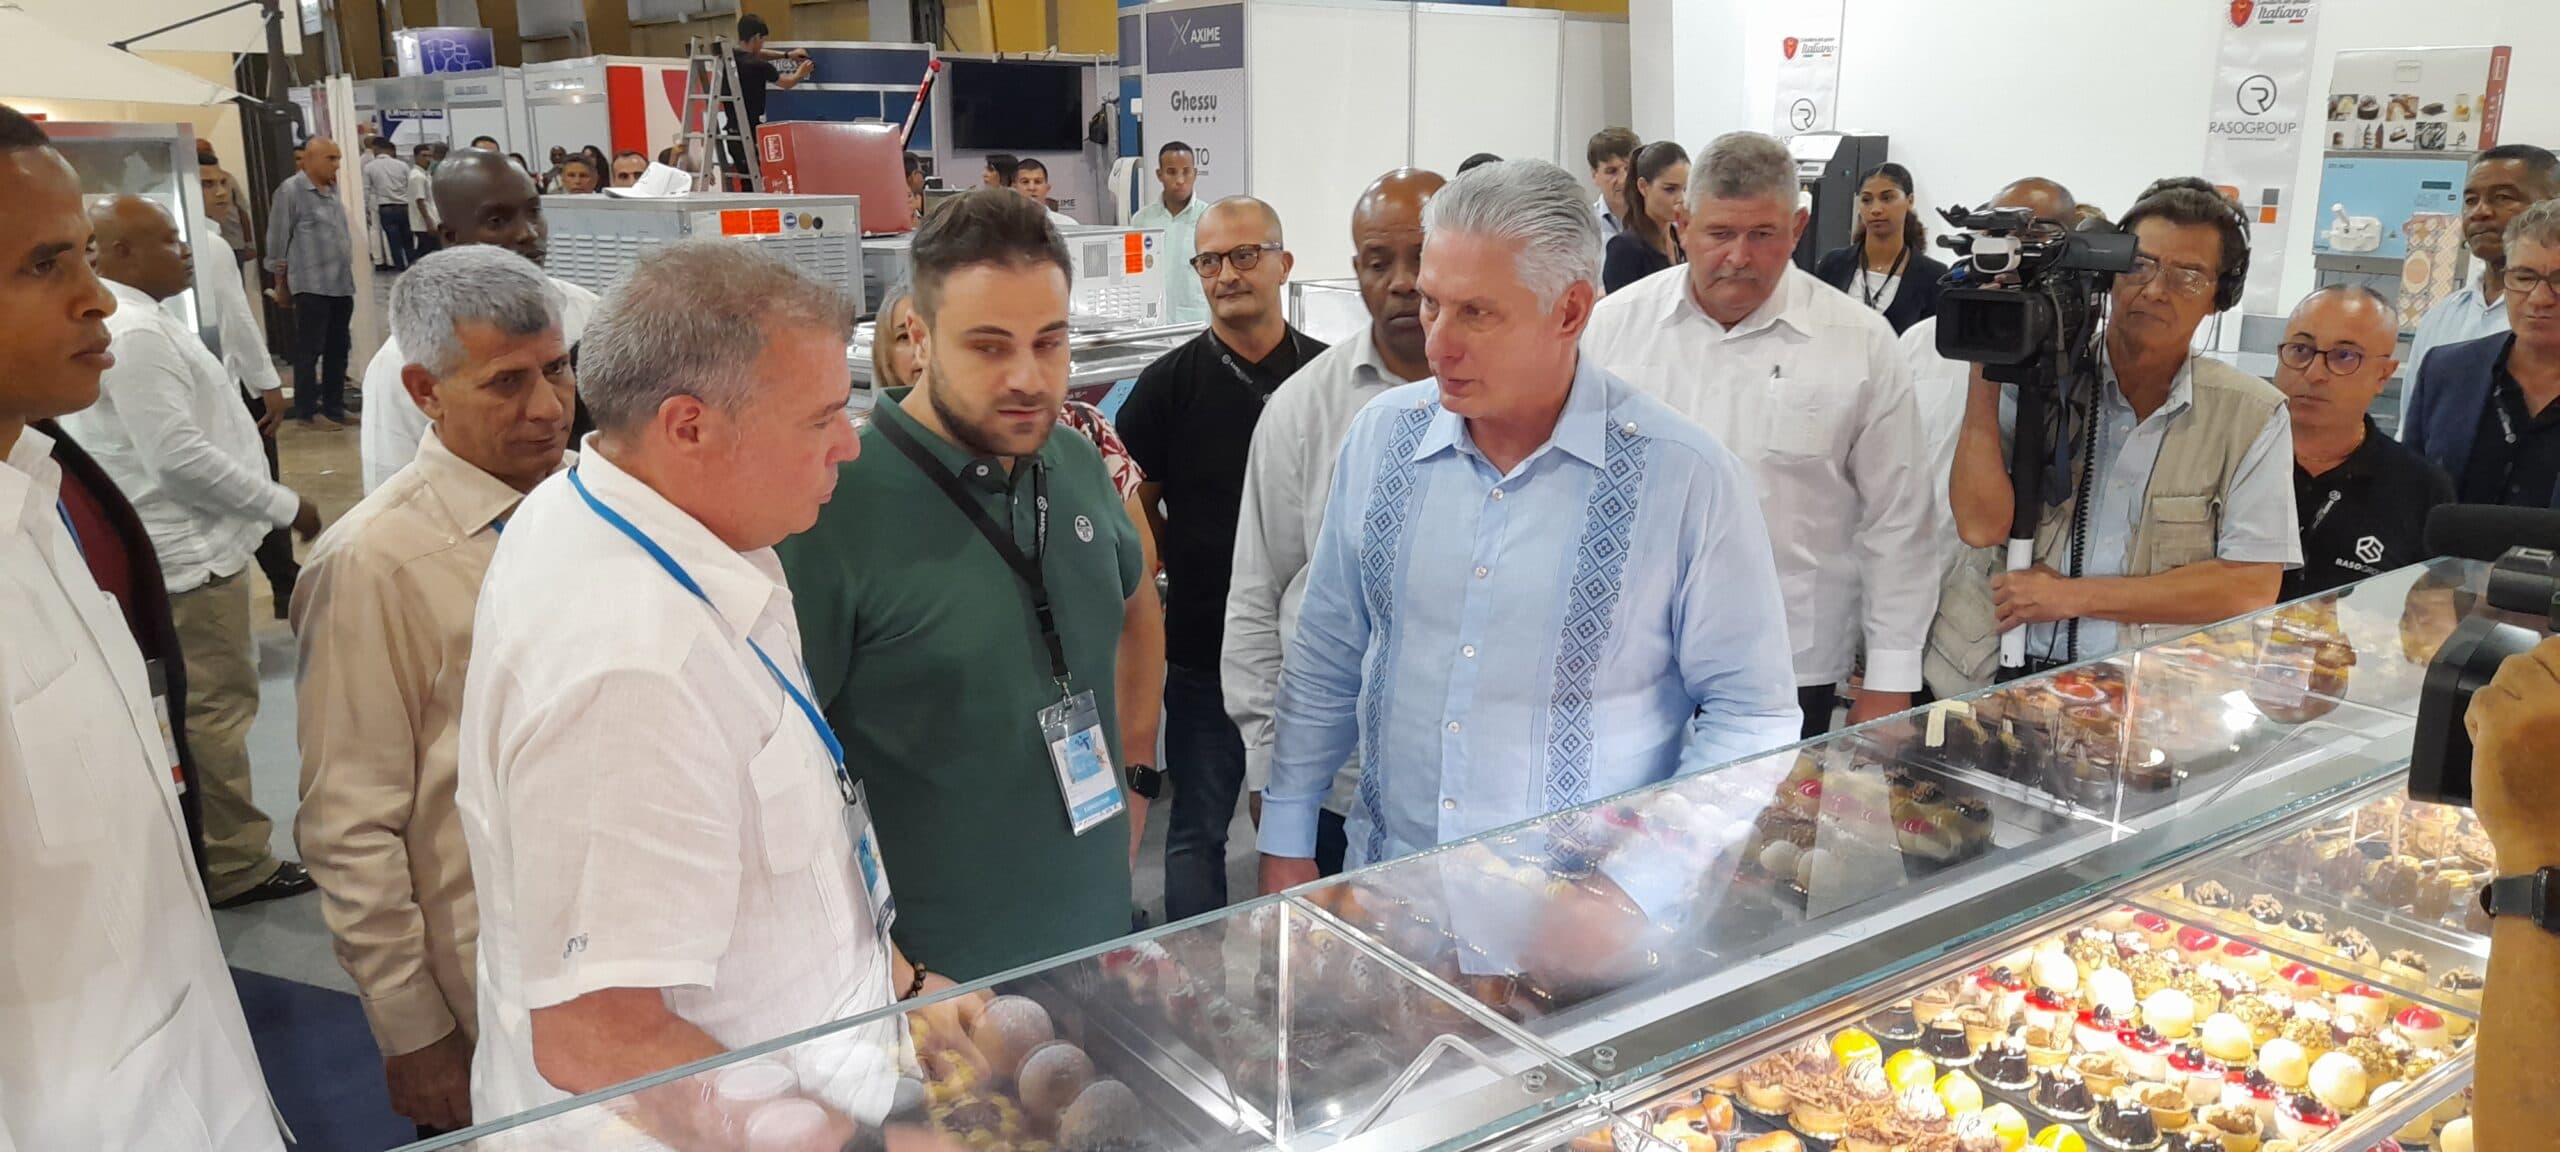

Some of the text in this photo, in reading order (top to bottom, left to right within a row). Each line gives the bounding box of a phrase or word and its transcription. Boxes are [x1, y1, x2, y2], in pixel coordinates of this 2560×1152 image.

[2258, 6, 2309, 20] Italiano
[1190, 26, 1221, 43] AXIME
[1171, 89, 1217, 111] Ghessu
[2208, 121, 2297, 135] RASOGROUP
[1195, 147, 1210, 166] TO
